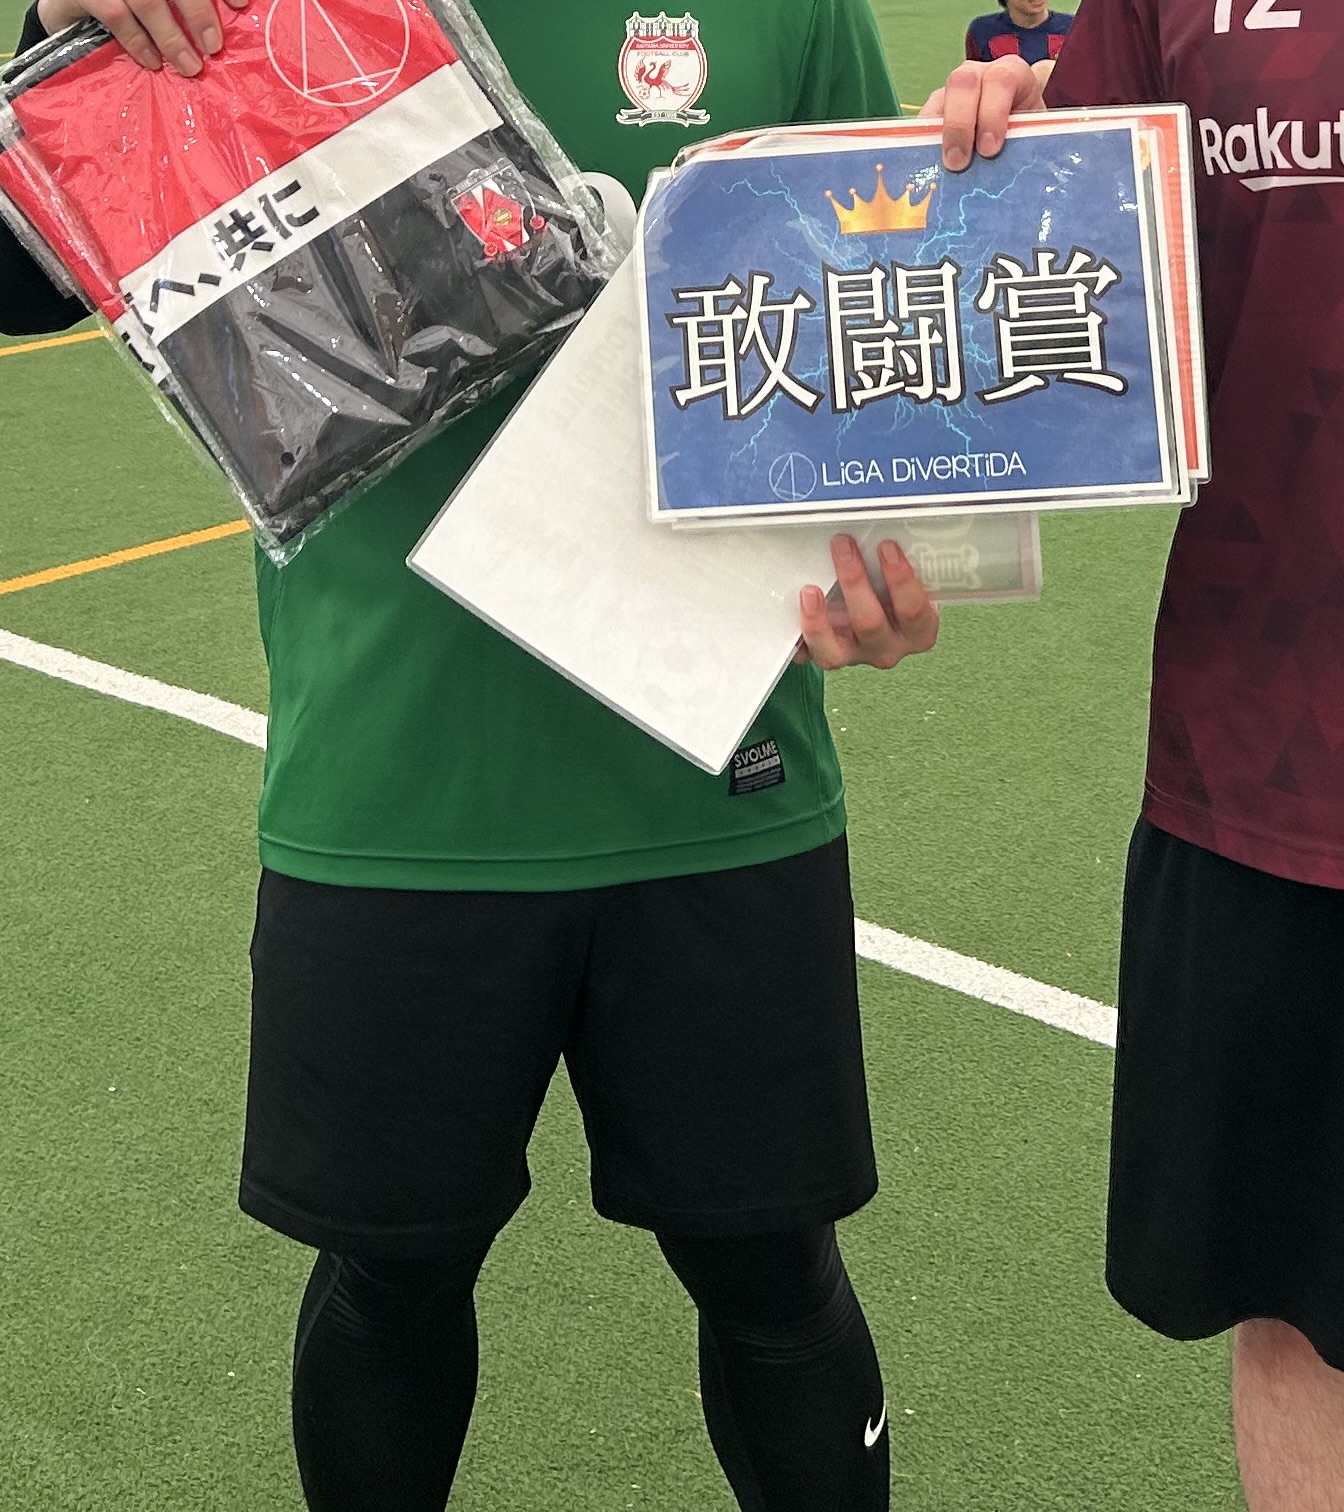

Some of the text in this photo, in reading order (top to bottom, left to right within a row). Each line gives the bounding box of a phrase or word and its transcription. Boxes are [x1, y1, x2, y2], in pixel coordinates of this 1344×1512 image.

[668, 248, 1128, 419] 敢闘賞
[733, 740, 779, 769] SVOLME
